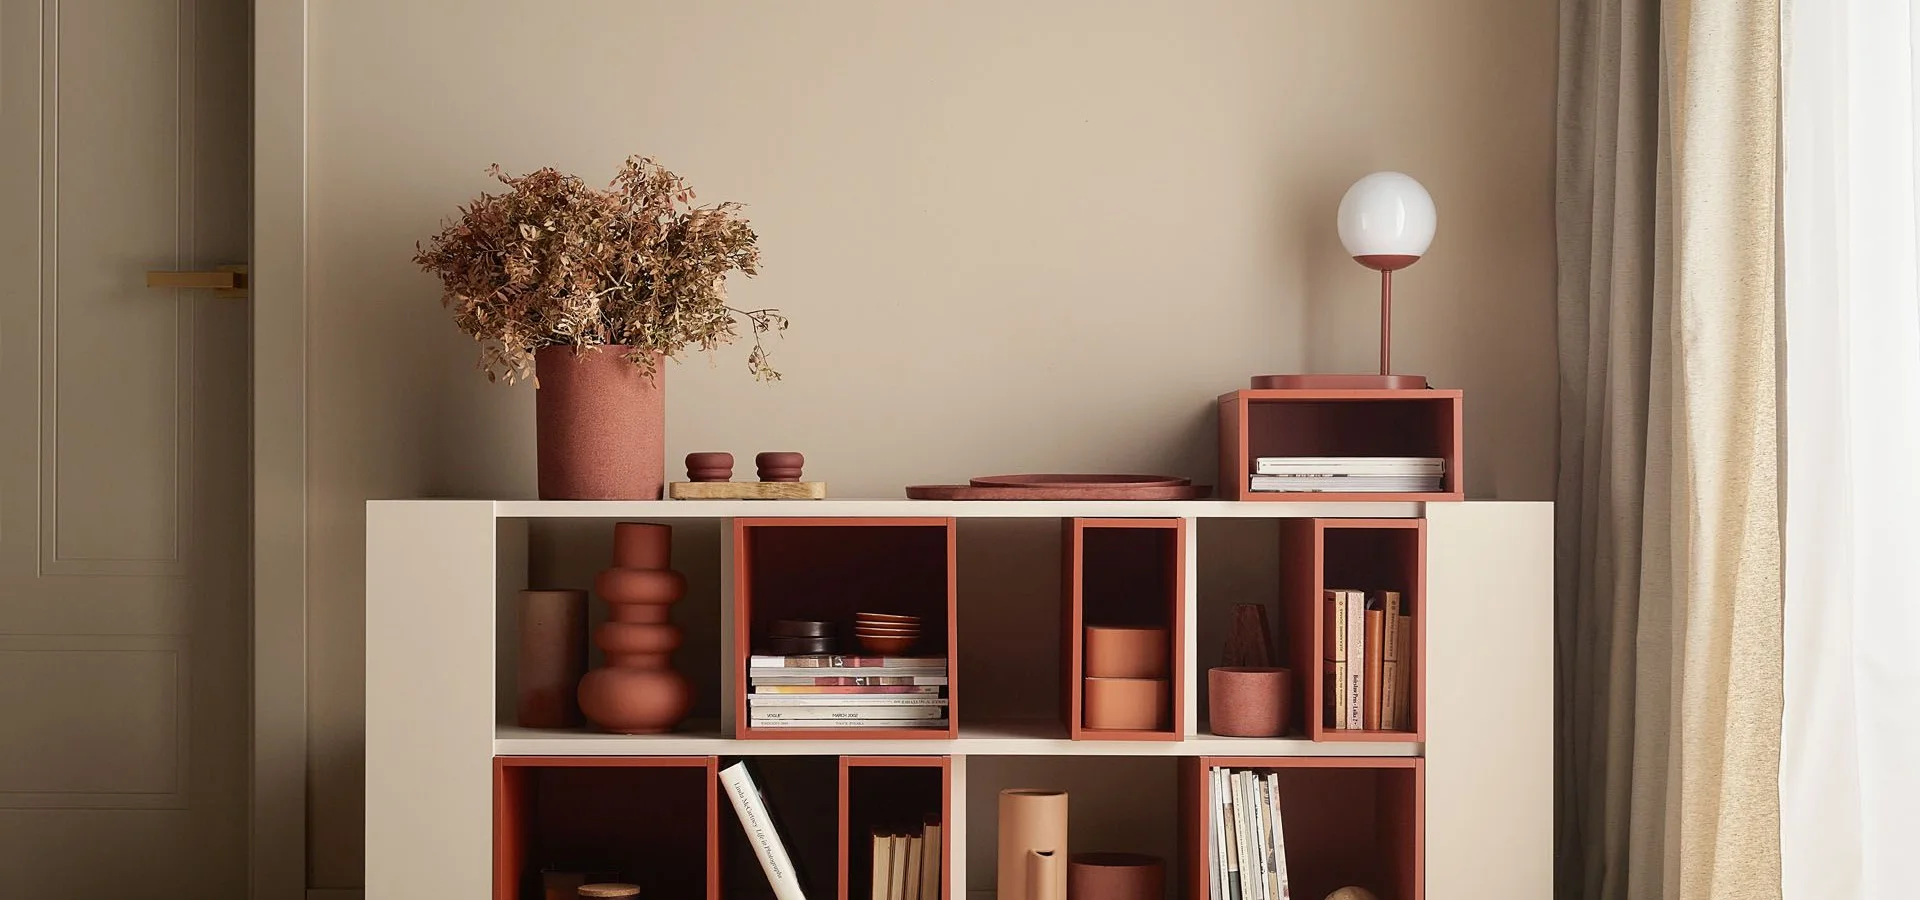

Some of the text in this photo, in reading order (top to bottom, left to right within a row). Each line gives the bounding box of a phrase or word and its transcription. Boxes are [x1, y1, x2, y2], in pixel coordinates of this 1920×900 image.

[734, 782, 744, 799] Linda
[742, 798, 757, 827] McCartney
[756, 828, 764, 840] Life
[764, 844, 782, 879] Photographs
